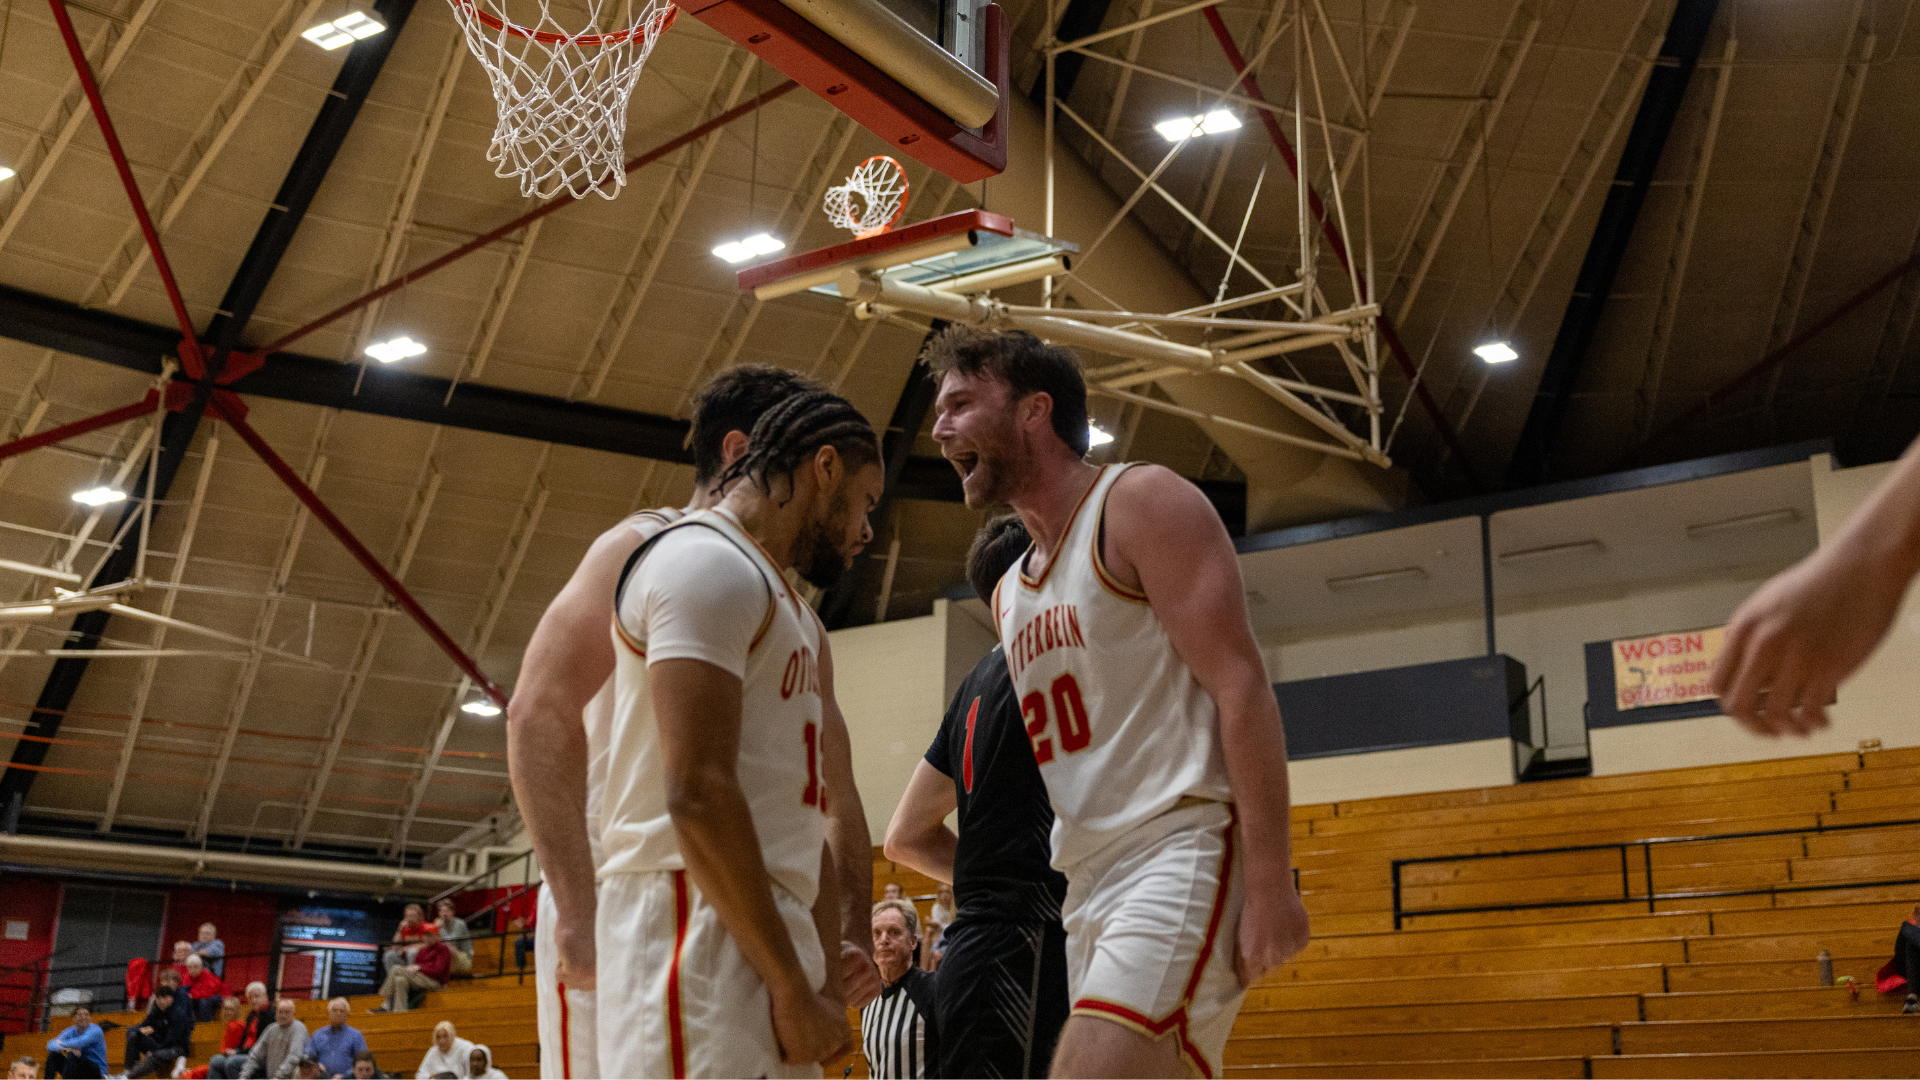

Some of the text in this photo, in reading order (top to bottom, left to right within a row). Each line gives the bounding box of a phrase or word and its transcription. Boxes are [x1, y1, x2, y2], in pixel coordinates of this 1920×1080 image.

[1007, 604, 1086, 683] TTERBEIN
[1620, 634, 1703, 662] WOBN
[802, 719, 827, 813] 1
[963, 695, 981, 795] 1
[1021, 671, 1092, 767] 20
